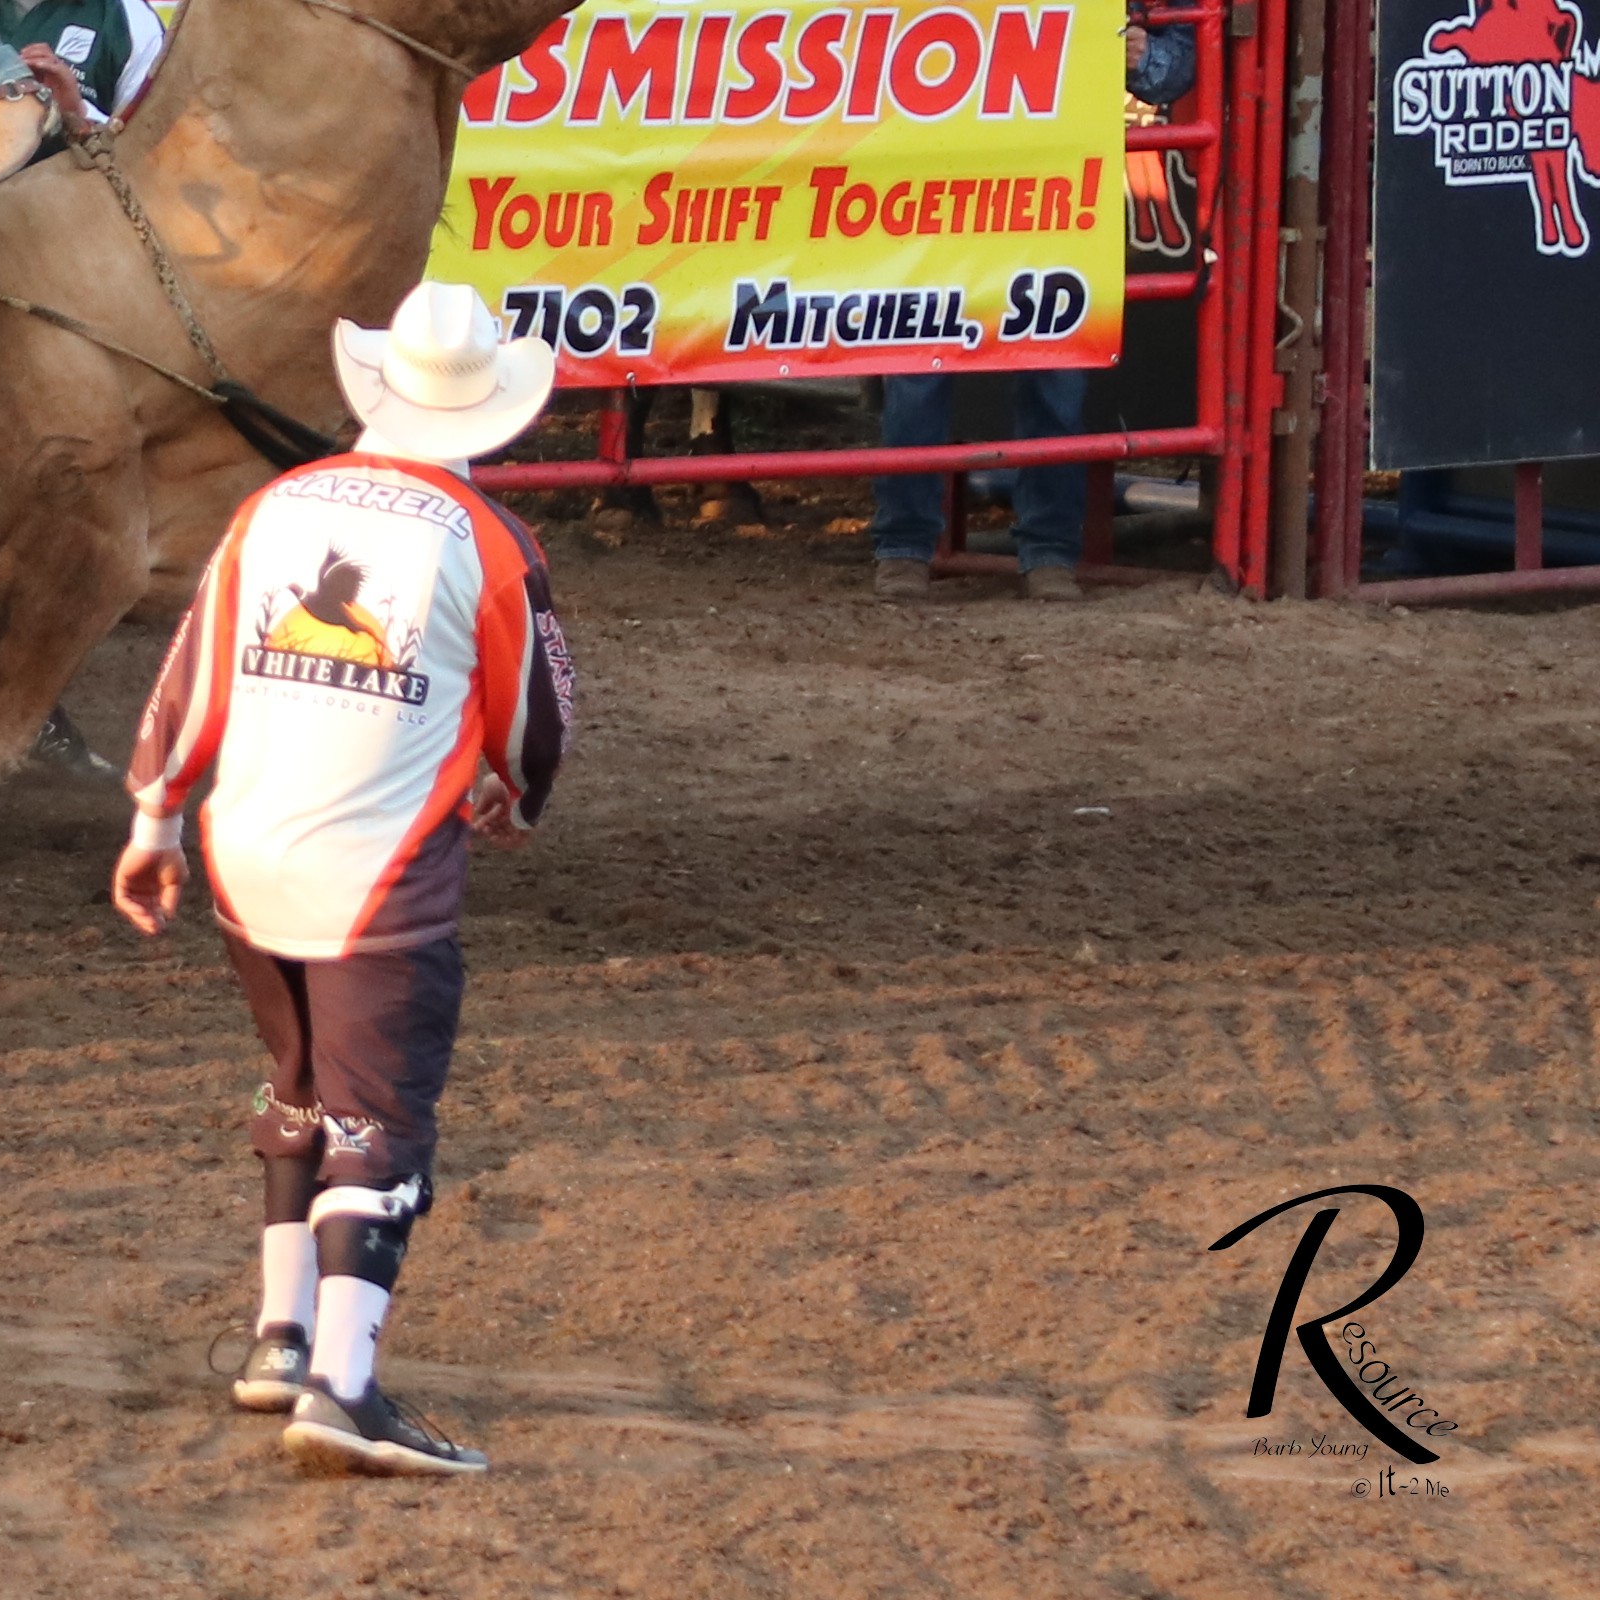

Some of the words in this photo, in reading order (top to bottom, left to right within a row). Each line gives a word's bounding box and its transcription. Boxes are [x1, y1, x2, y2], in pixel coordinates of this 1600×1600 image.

[1401, 61, 1574, 122] SUTTON
[1443, 116, 1571, 155] RODEO
[1453, 158, 1482, 175] BORN
[1483, 156, 1498, 173] TO
[1498, 154, 1526, 172] BUCK
[469, 175, 614, 251] YOUR
[636, 170, 784, 247] SHIFT
[810, 157, 1103, 241] TOGETHER!
[493, 281, 660, 359] 7102
[1001, 267, 1090, 340] SD
[275, 473, 471, 541] HARRELL
[340, 661, 427, 701] LAKE
[396, 709, 429, 727] LLC
